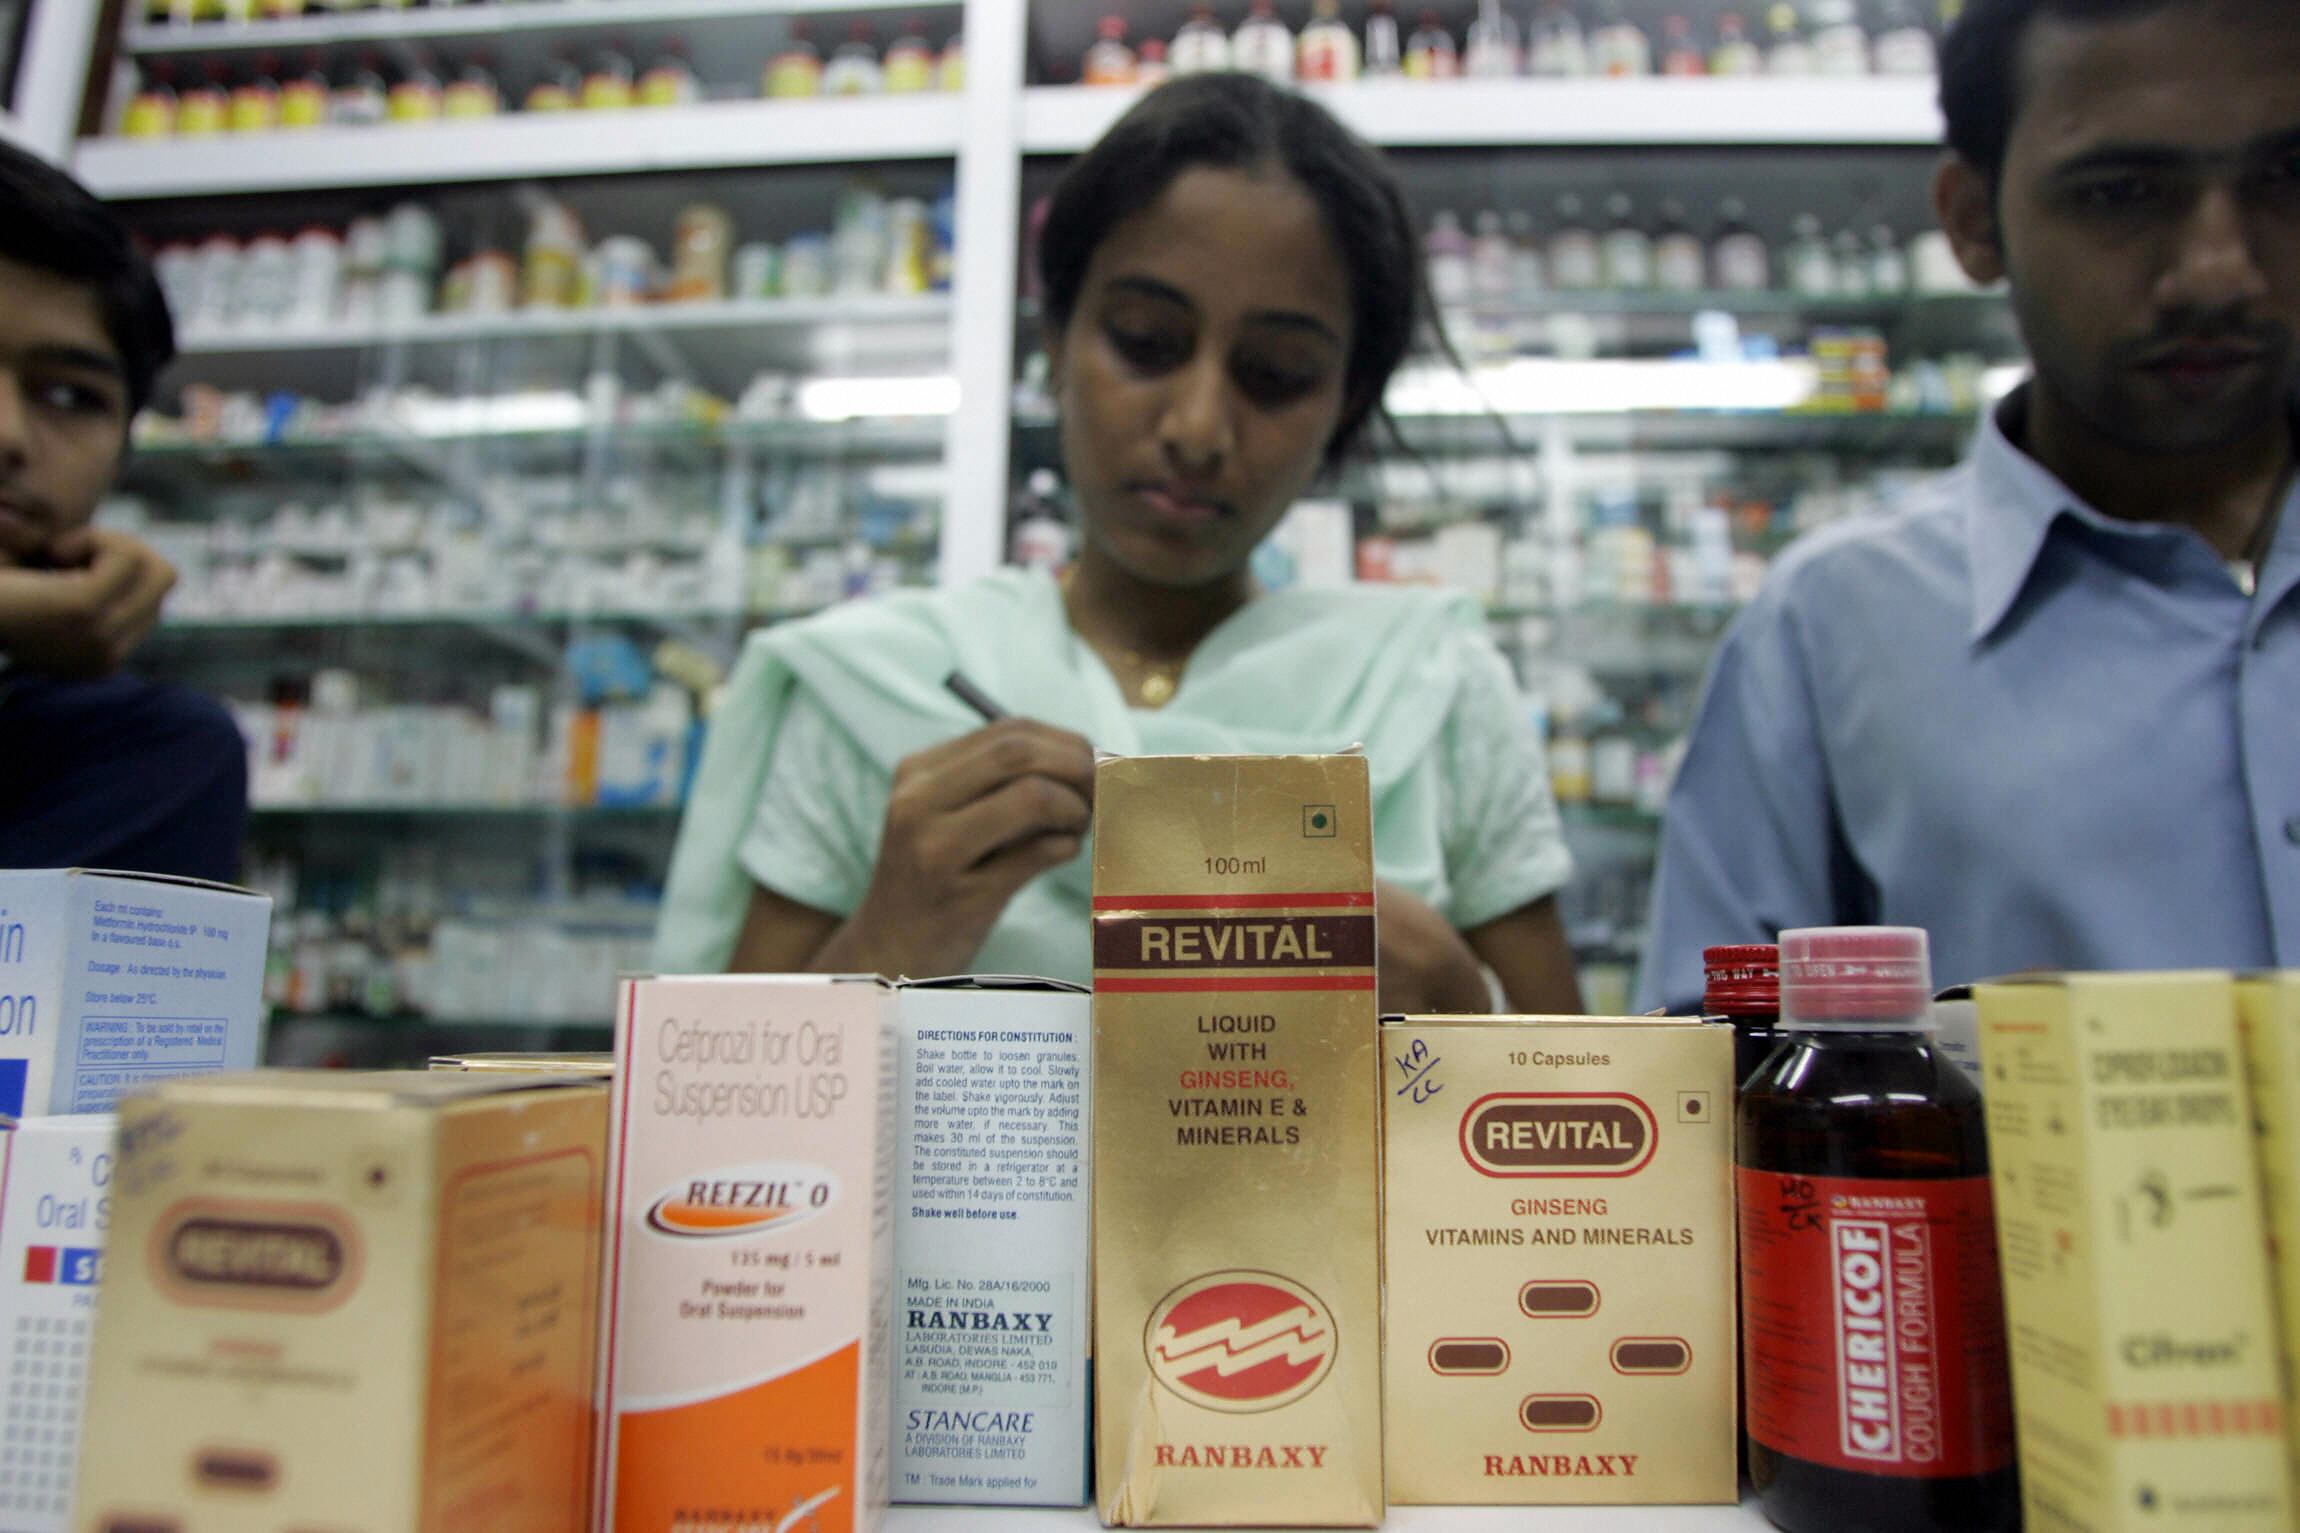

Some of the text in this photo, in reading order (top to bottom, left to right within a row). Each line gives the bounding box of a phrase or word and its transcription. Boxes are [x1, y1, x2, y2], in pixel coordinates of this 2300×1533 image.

[1141, 924, 1334, 961] REVITAL
[1198, 1015, 1276, 1033] LIQUID
[918, 1030, 1072, 1043] DIRECTIONS FOR CONSTITUTION
[658, 1017, 845, 1073] Cefprozil for Oral
[1208, 1043, 1266, 1061] WITH
[917, 1049, 945, 1060] Shake
[952, 1050, 977, 1060] bottle
[984, 1050, 992, 1060] to
[1000, 1051, 1030, 1061] loosen
[1508, 1051, 1611, 1068] 10 Capsules
[916, 1063, 934, 1073] Boil
[969, 1064, 994, 1073] allow
[998, 1065, 1003, 1074] it
[1008, 1065, 1017, 1074] to
[1048, 1065, 1080, 1078] Slowly
[916, 1077, 1079, 1090] add cooled water upto the mark on
[654, 1070, 848, 1125] Suspension USP
[916, 1090, 929, 1100] the
[962, 1091, 991, 1101] Shake
[1050, 1093, 1080, 1104] Adjust
[1169, 1099, 1306, 1116] VITAMIN E &
[914, 1133, 1078, 1147] makes 30 ml of the suspension.
[1177, 1126, 1300, 1145] MINERALS
[1486, 1121, 1633, 1149] REVITAL
[915, 1146, 1078, 1159] The constituted suspension should
[913, 1174, 969, 1185] temperature
[973, 1175, 1012, 1186] between
[1026, 1177, 1035, 1186] to
[1060, 1177, 1078, 1187] and
[912, 1188, 935, 1198] used
[937, 1189, 965, 1199] within
[968, 1190, 979, 1199] 14
[981, 1190, 1003, 1201] days
[1006, 1190, 1015, 1199] of
[36, 1194, 87, 1228] Oral
[912, 1207, 941, 1218] Shake
[944, 1208, 962, 1218] well
[966, 1209, 997, 1219] before
[1511, 1199, 1608, 1215] GINSENG
[1426, 1229, 1694, 1246] VITAMINS AND MINERALS
[907, 1296, 994, 1308] MADE IN INDIA
[908, 1310, 1052, 1331] RANBAXY
[906, 1331, 1052, 1345] LABORATORIES LIMITED
[1840, 1228, 1891, 1450] CHERICOF
[1894, 1222, 1936, 1463] COUGH FORMULA
[959, 1347, 998, 1356] DEWAS
[965, 1360, 1007, 1369] INDORE
[922, 1383, 956, 1393] INDORE
[907, 1410, 1035, 1433] STANCARE
[905, 1433, 1025, 1446] A DIVISION OF RANBAXY
[905, 1447, 1025, 1460] LABORATORIES LIMITED
[1154, 1444, 1328, 1468] RANBAXY
[1484, 1456, 1638, 1476] RANBAXY
[905, 1473, 1037, 1489] TM Trade Mark applied for
